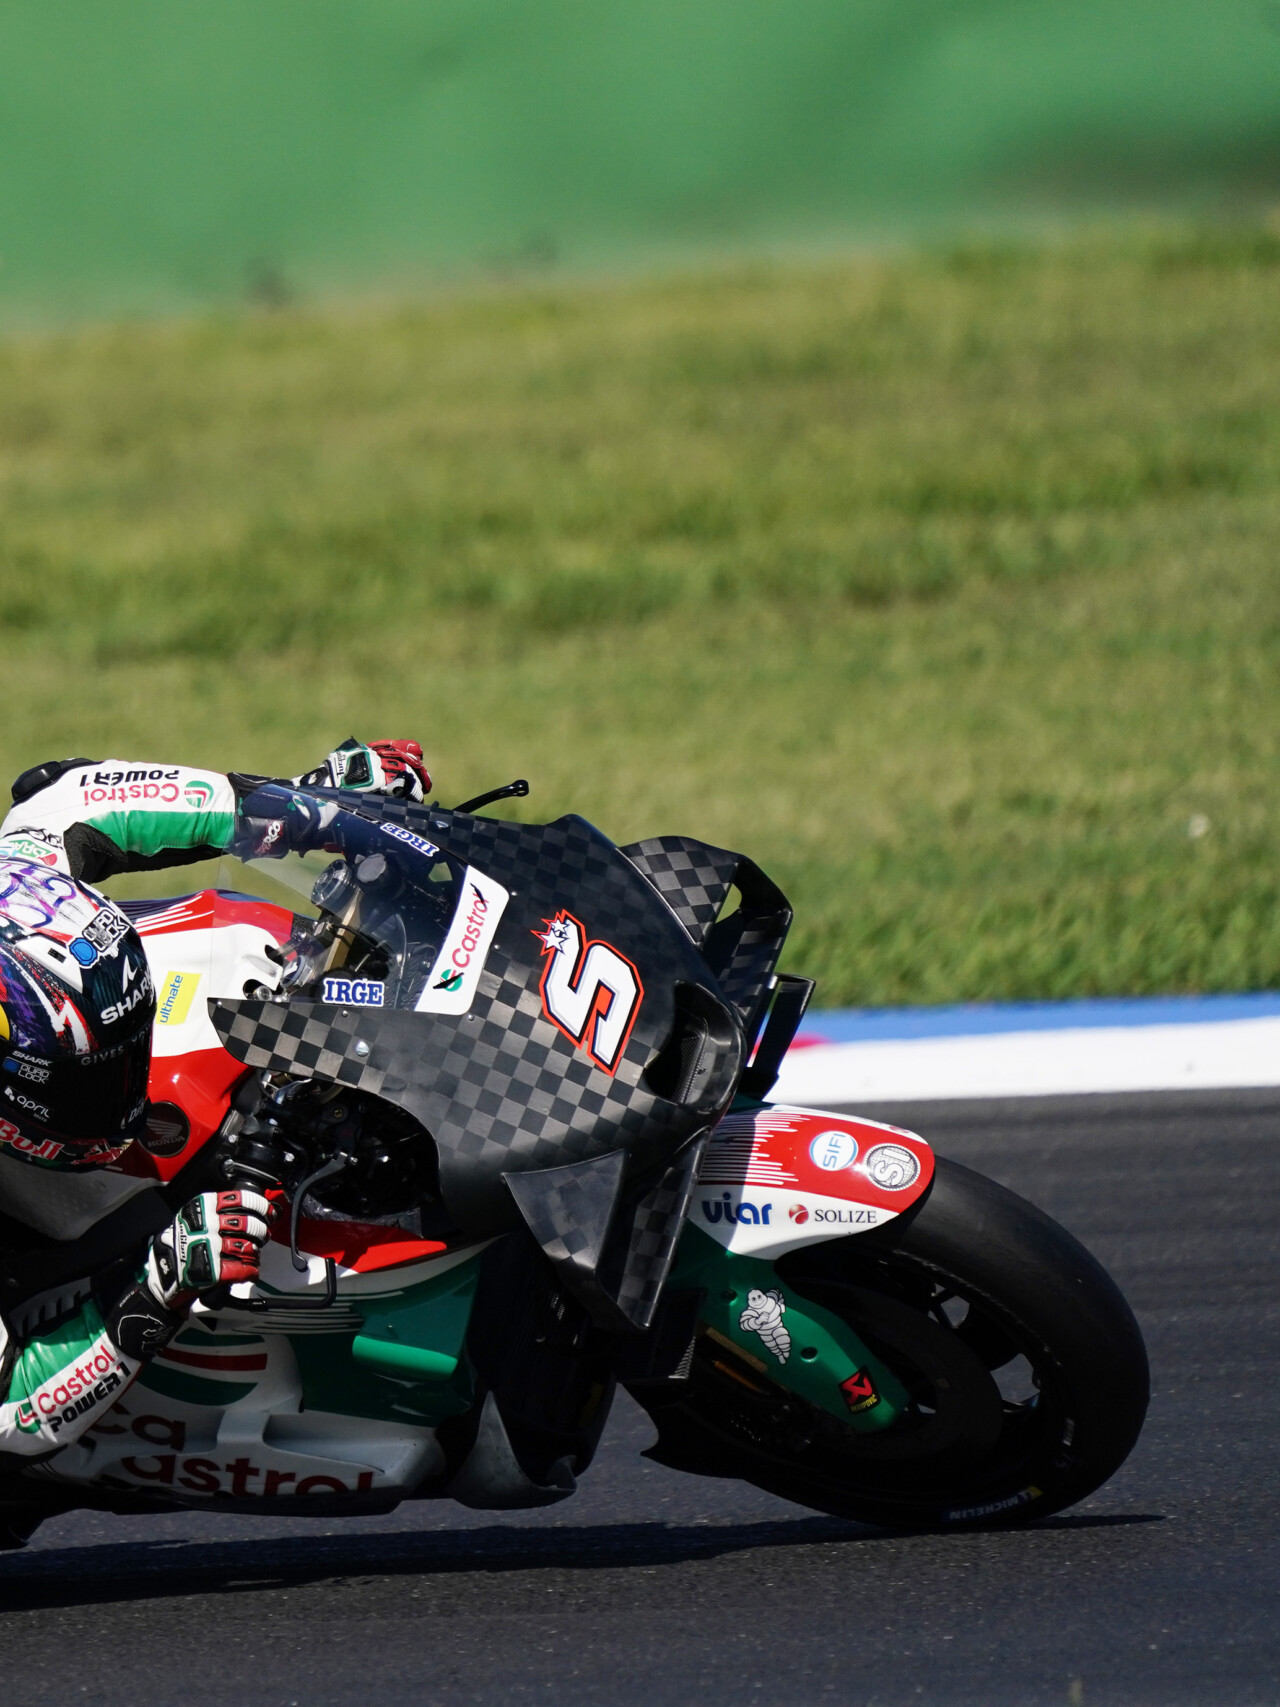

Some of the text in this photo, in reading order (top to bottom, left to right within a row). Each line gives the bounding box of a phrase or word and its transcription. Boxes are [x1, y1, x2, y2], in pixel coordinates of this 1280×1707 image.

[83, 783, 180, 806] Castrol
[383, 822, 440, 857] IRGE
[159, 974, 184, 1024] ultimate
[324, 980, 384, 1006] IRGE
[542, 912, 643, 1074] 5
[12, 1050, 52, 1067] SHARK
[20, 1063, 50, 1078] QUAD
[18, 1070, 48, 1085] LOCK
[147, 1134, 186, 1148] HONDA
[822, 1132, 846, 1169] SIFI
[702, 1192, 877, 1225] viar SOLIZE
[37, 1344, 117, 1415] Castrol
[949, 1494, 1020, 1521] MICHELIN
